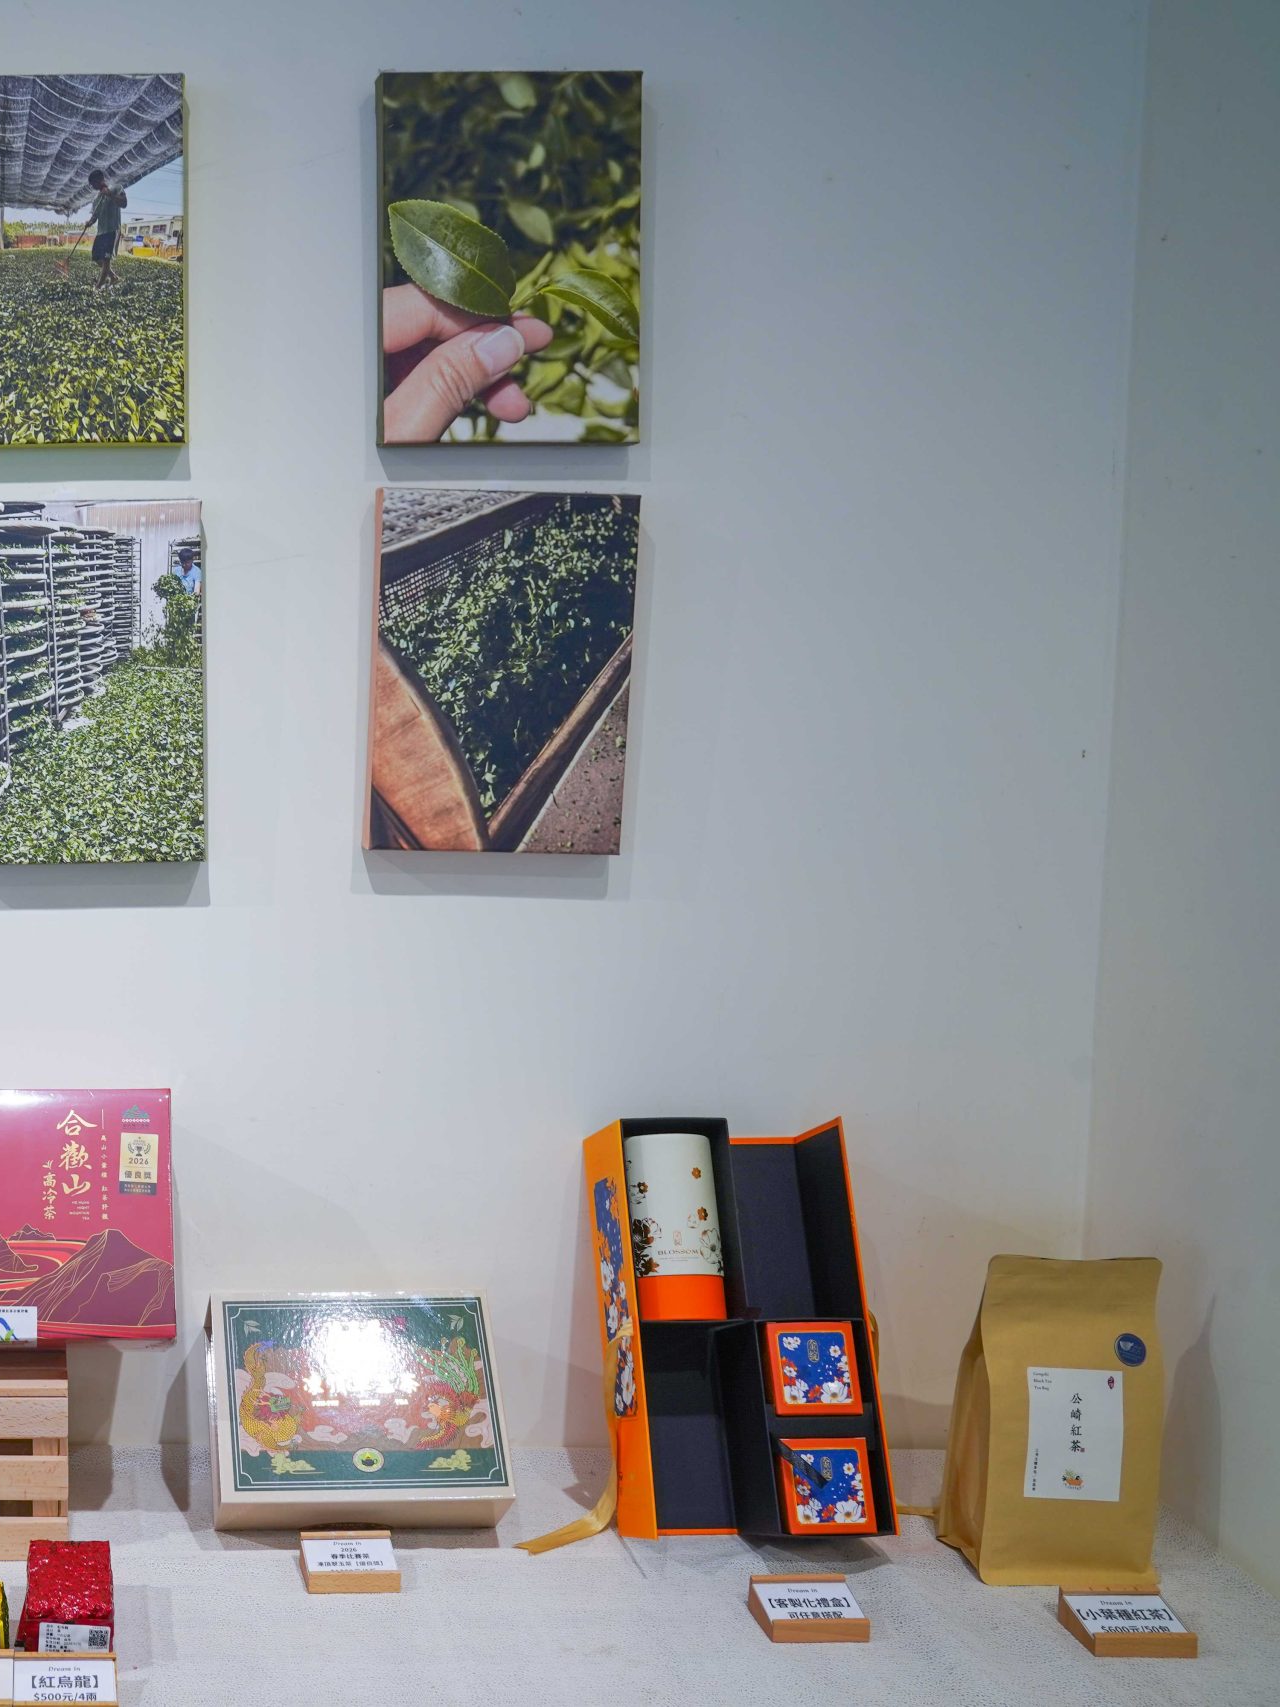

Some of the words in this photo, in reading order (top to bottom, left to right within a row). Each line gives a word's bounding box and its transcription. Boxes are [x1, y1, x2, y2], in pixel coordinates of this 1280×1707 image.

[56, 1109, 98, 1196] 合歡山
[128, 1157, 149, 1165] 2026
[42, 1172, 57, 1220] 高冷茶
[768, 1597, 851, 1609] 【客製化禮盒】
[1076, 1608, 1174, 1621] 【小葉種紅茶】
[31, 1675, 99, 1689] 【紅烏龍】
[33, 1692, 97, 1702] $500元/4兩
